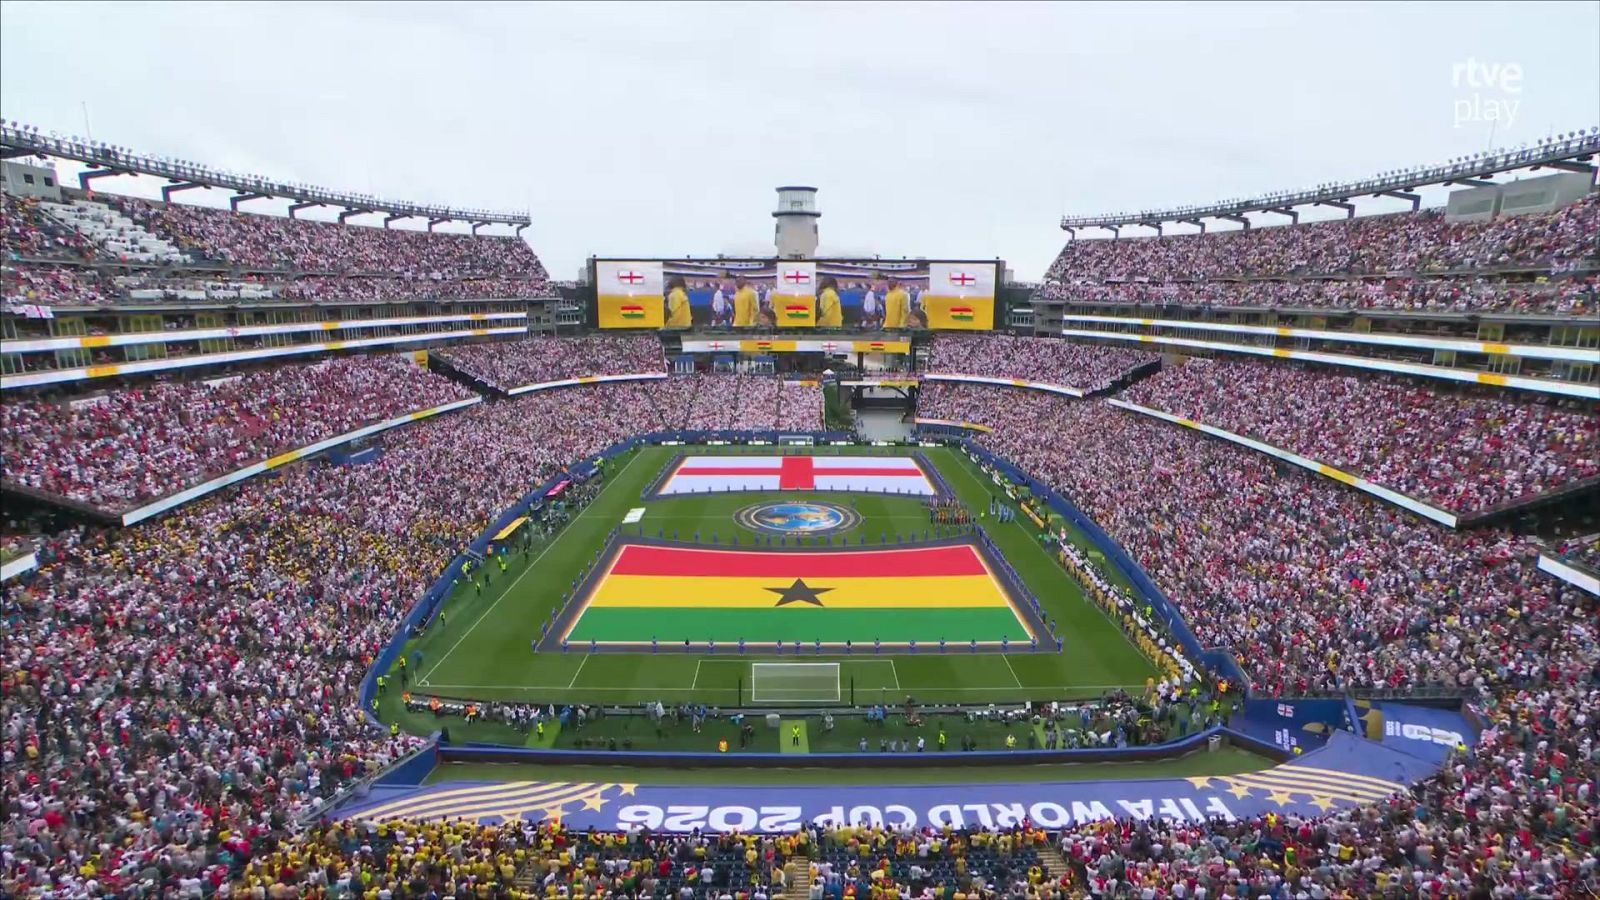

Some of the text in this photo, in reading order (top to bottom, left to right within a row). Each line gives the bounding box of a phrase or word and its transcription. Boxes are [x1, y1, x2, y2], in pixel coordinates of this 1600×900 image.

[616, 797, 1237, 832] FIFA WORLD CUP 2026
